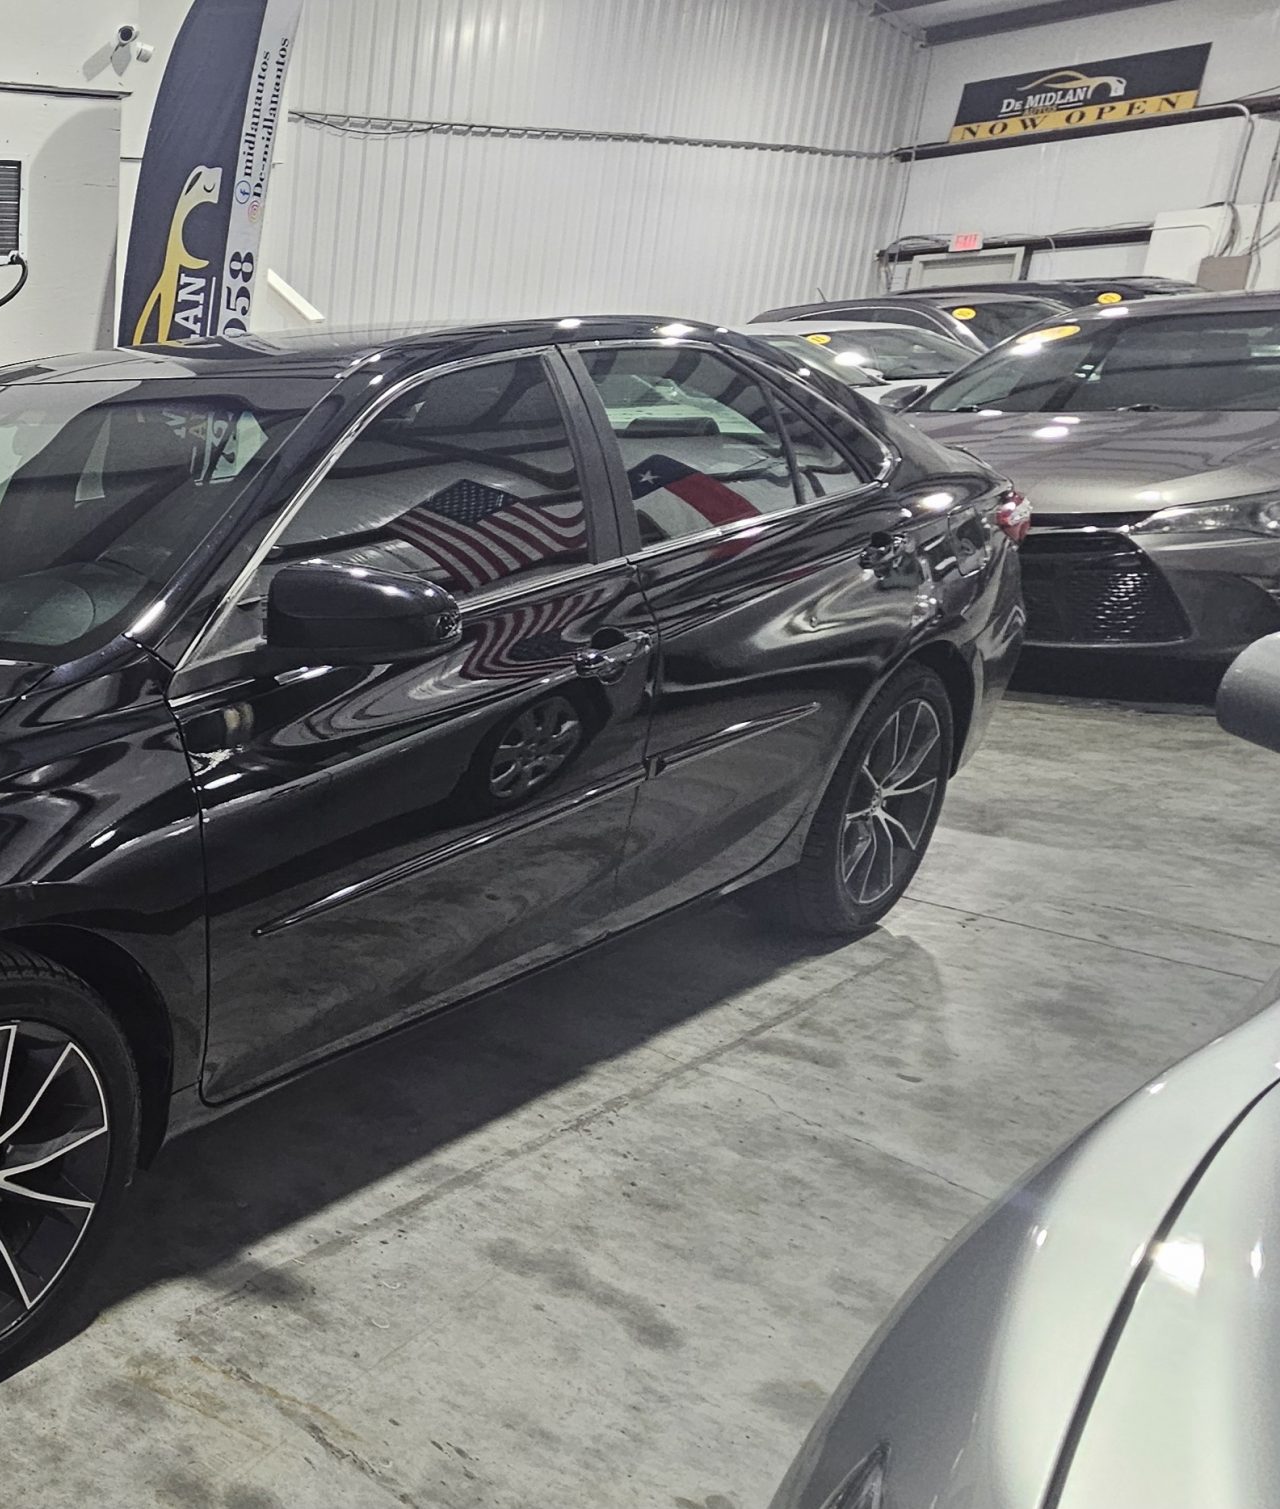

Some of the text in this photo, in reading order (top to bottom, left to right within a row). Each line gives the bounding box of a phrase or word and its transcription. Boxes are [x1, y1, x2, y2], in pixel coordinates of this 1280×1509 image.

[241, 50, 271, 178] midlanautos
[253, 37, 290, 198] De-midlanautos
[960, 95, 1182, 140] NOW OPEN
[1024, 87, 1088, 109] MIDLAN
[955, 233, 978, 250] EXIT
[174, 272, 207, 338] AN
